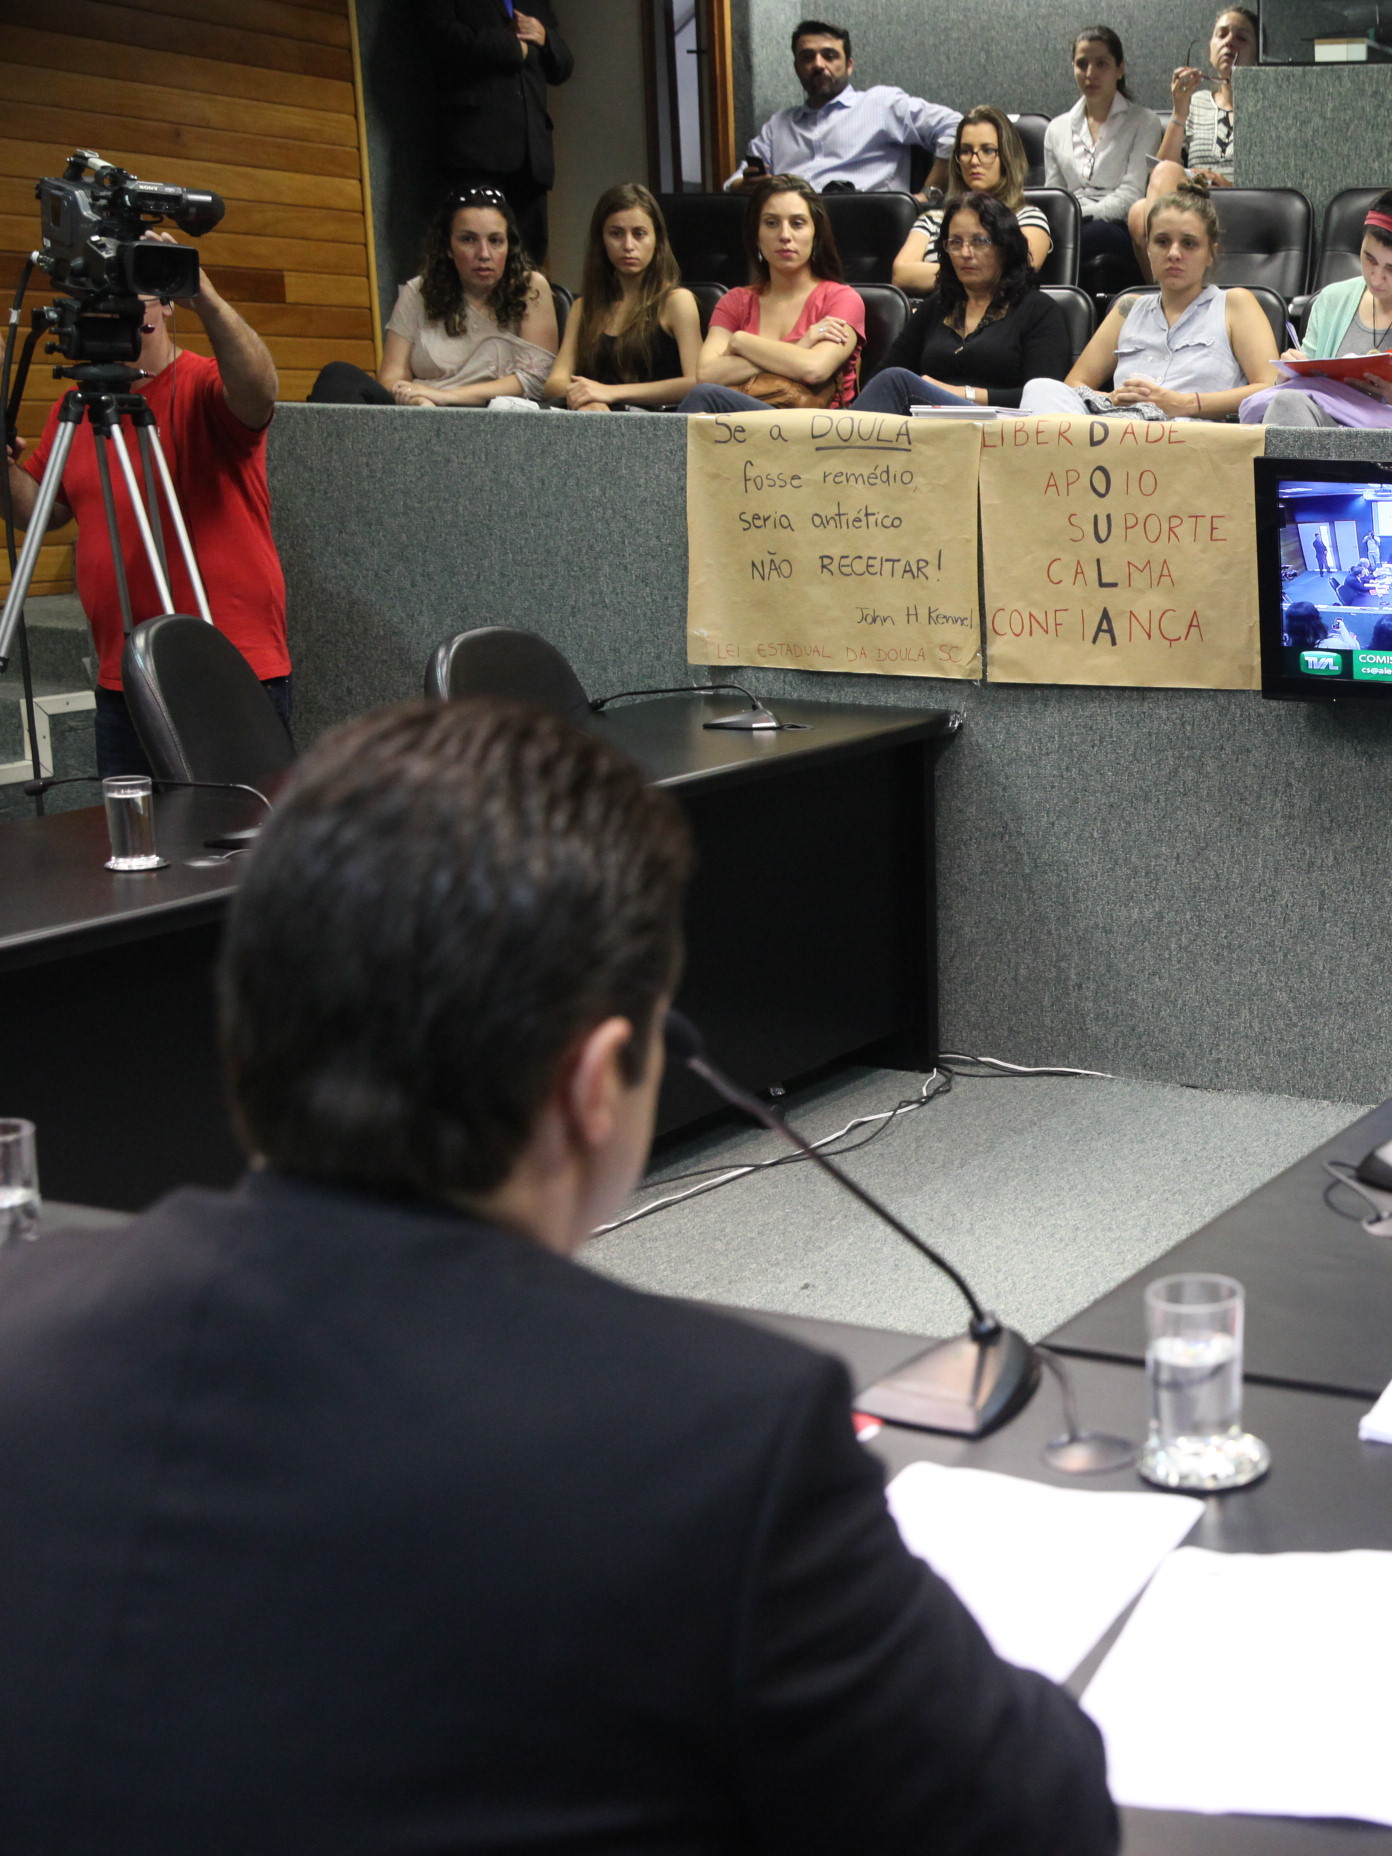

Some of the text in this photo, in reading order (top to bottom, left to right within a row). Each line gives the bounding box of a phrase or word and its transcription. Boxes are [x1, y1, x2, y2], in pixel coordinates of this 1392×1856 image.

[714, 414, 913, 445] Se a DOULA
[981, 420, 1187, 448] LIBERDADE
[743, 460, 804, 494] fosse
[1044, 465, 1159, 499] APOIO
[739, 501, 903, 532] seria antiético
[1068, 513, 1228, 544] SUPORTE
[751, 550, 793, 582] NÃO
[1046, 557, 1175, 589] CALMA
[856, 607, 896, 627] John
[991, 606, 1204, 649] CONFIANÇA
[715, 643, 963, 664] LEI ESTADUAL DA DOULA SC
